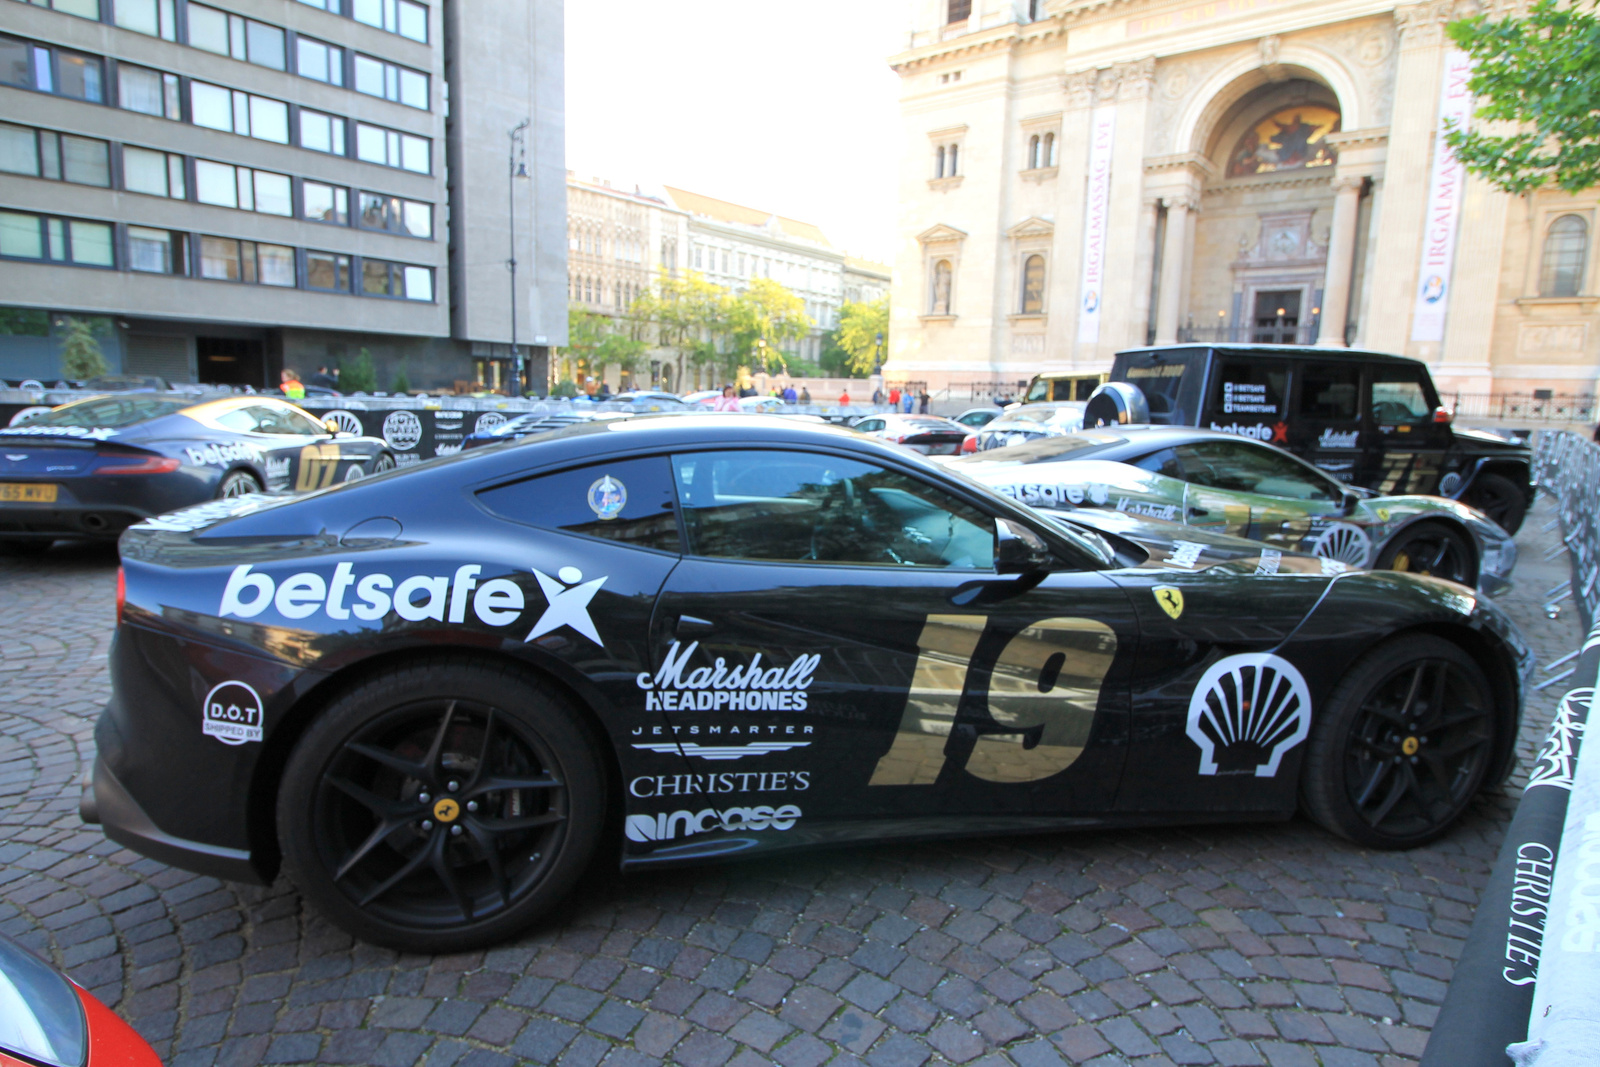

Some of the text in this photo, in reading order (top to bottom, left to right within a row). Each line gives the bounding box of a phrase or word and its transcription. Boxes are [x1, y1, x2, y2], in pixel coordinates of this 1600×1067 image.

[296, 444, 340, 491] 07
[218, 561, 526, 627] betsafe
[636, 640, 822, 690] Marshall
[645, 690, 808, 711] HEADPHONES
[867, 613, 1118, 786] 19
[204, 722, 261, 738] SHIPPED BY
[631, 725, 814, 736] JETSMARTER
[629, 771, 811, 798] CHRISTIE'S
[656, 804, 802, 841] incase
